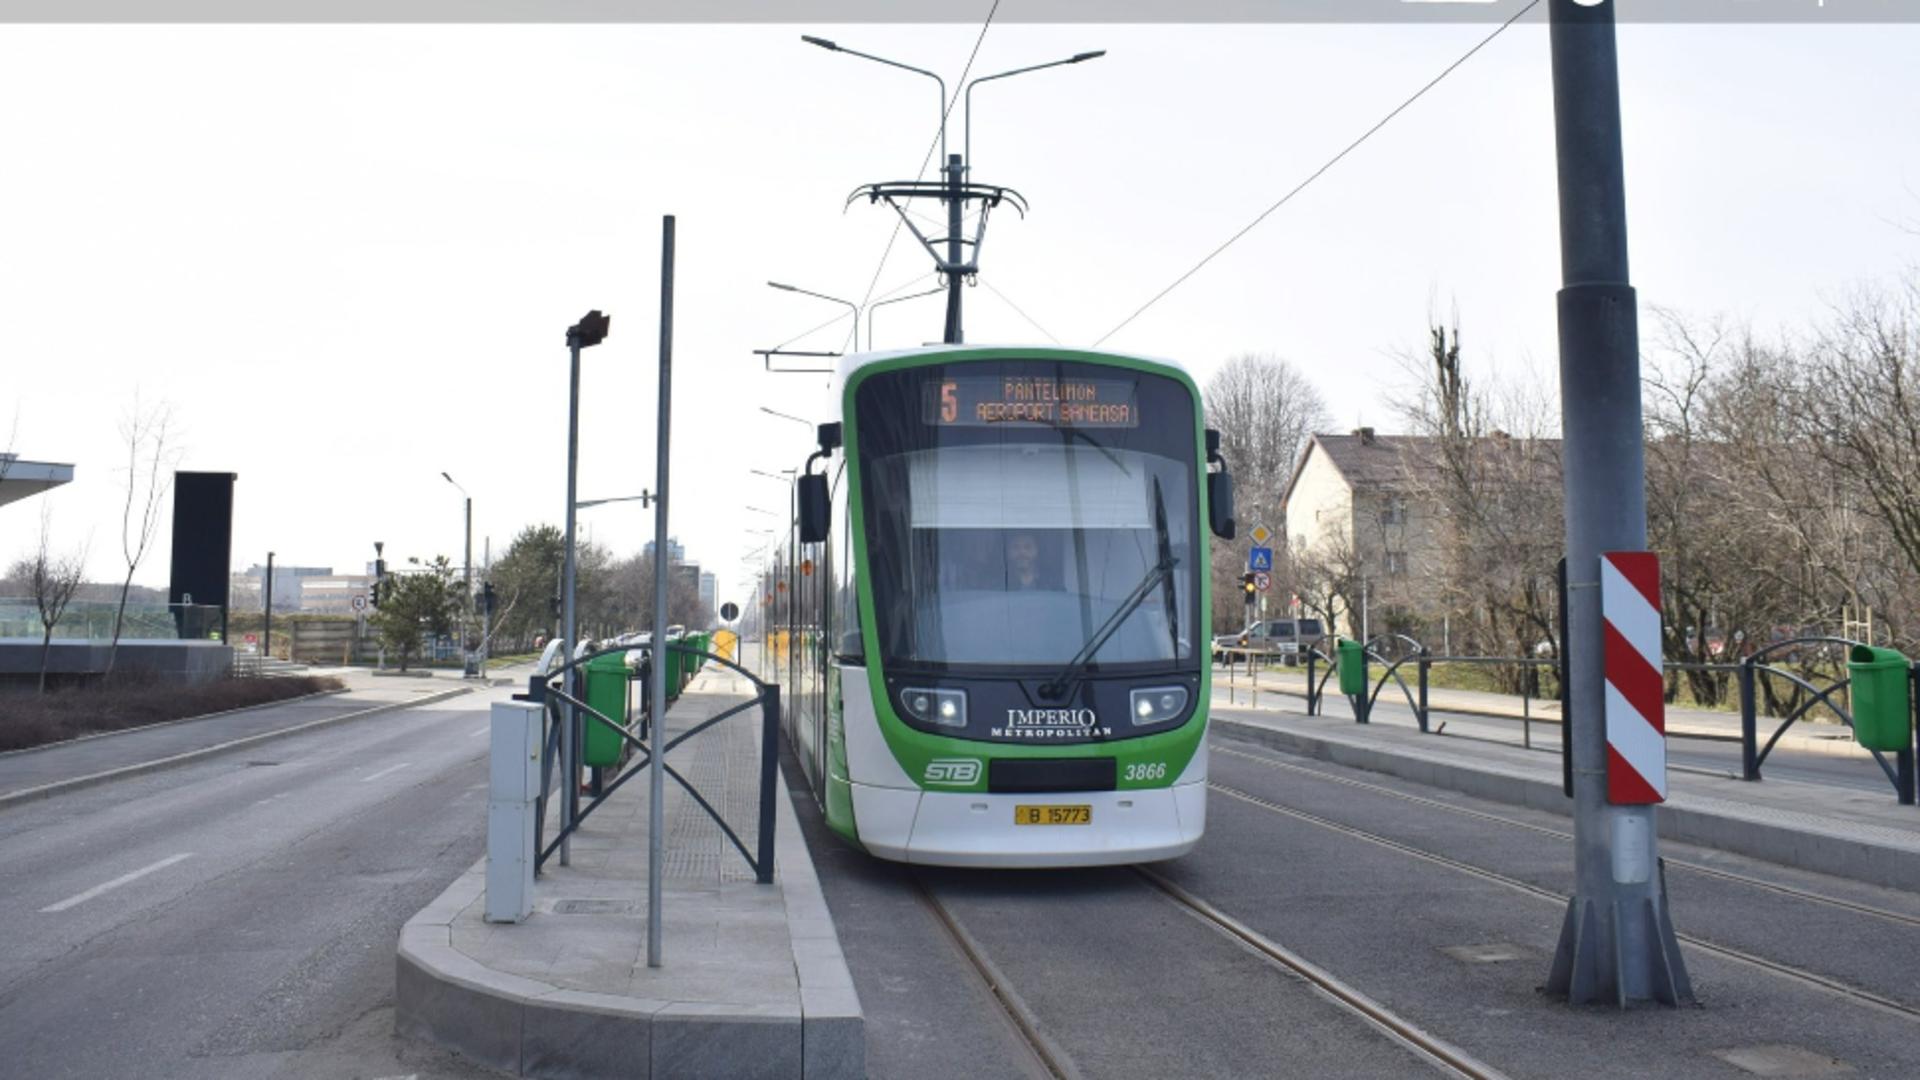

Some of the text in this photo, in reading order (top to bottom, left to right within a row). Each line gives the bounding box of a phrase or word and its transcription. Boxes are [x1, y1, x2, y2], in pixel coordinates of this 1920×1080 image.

[1005, 382, 1096, 400] PANTELIMON
[940, 382, 957, 422] 5
[976, 402, 1053, 422] AEROPORT
[1007, 708, 1096, 728] IMPERIO
[991, 727, 1112, 737] METROPOLITAN
[924, 762, 978, 781] STB
[1124, 763, 1167, 781] 3866
[1029, 807, 1090, 823] B 15773
